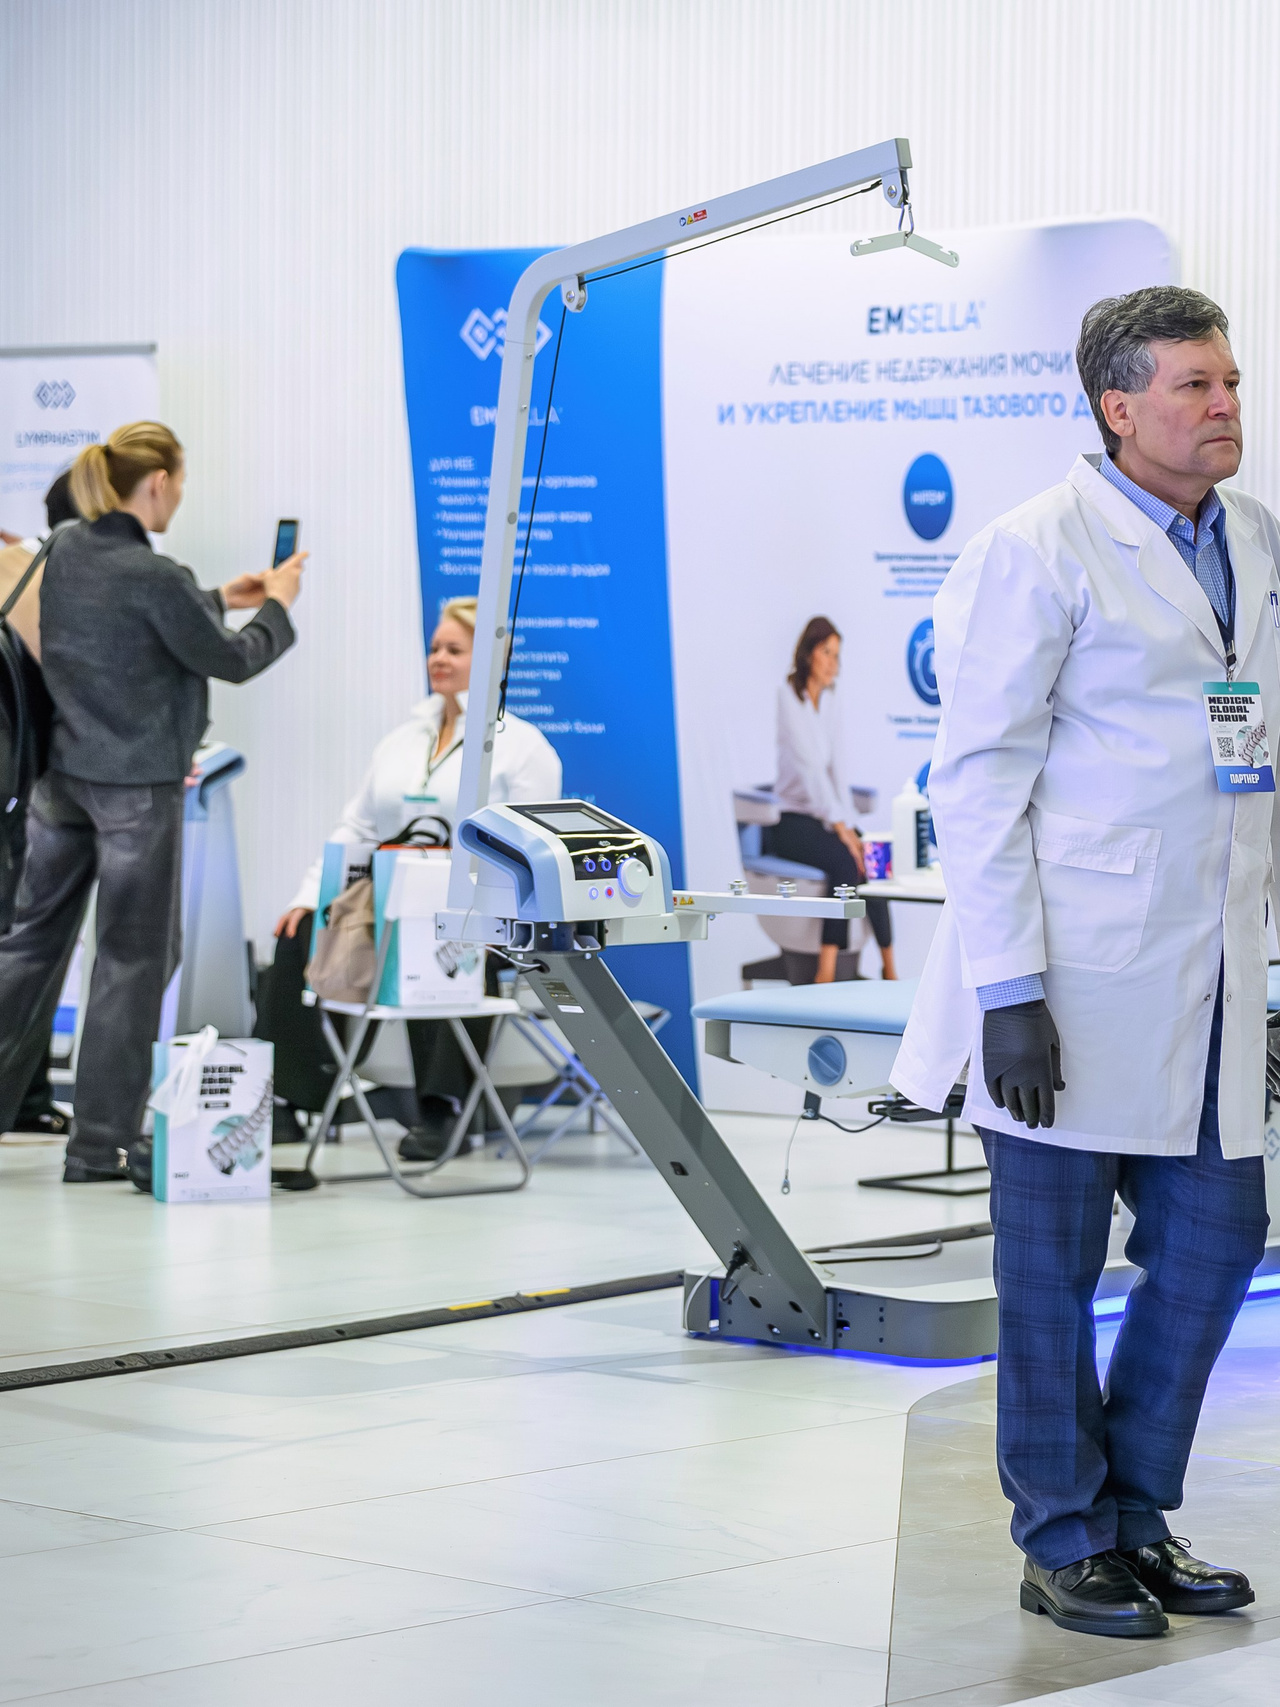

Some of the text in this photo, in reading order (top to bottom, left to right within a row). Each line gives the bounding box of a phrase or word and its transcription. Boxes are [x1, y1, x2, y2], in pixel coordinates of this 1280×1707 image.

[868, 302, 980, 334] EMSELLA
[769, 350, 1074, 385] ЛЕЧЕНИЕ НЕДЕРЖАНИЯ МОЧИ
[717, 403, 735, 425] И
[742, 397, 887, 425] УКРЕПЛЕНИЕ
[892, 396, 957, 422] МЫШЦ
[963, 391, 1067, 418] ТАЗОВОГО
[1208, 696, 1255, 705] MEDICAL
[1209, 705, 1250, 714] GLOBAL
[1210, 714, 1248, 722] FORUM
[1229, 773, 1259, 784] ПАРТНЕР
